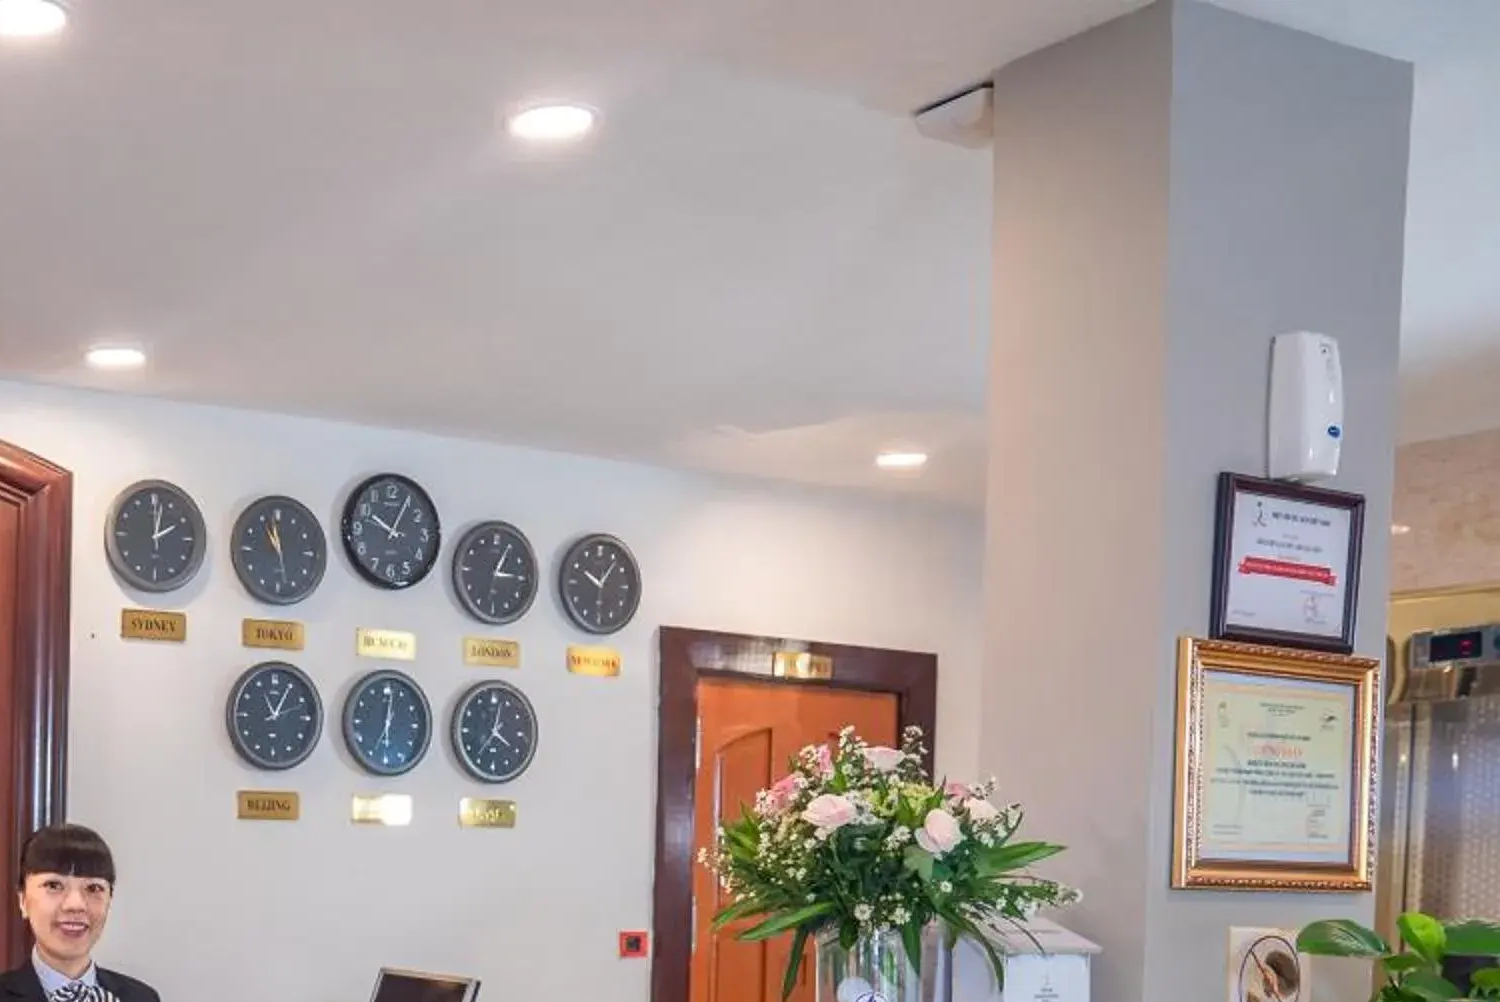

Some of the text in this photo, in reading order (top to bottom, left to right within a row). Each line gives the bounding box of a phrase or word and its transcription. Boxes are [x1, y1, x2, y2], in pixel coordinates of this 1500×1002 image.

[131, 617, 176, 633] SYDNEY
[256, 627, 293, 641] TOKYO
[470, 645, 512, 659] LONDON
[247, 798, 291, 812] BEIJING
